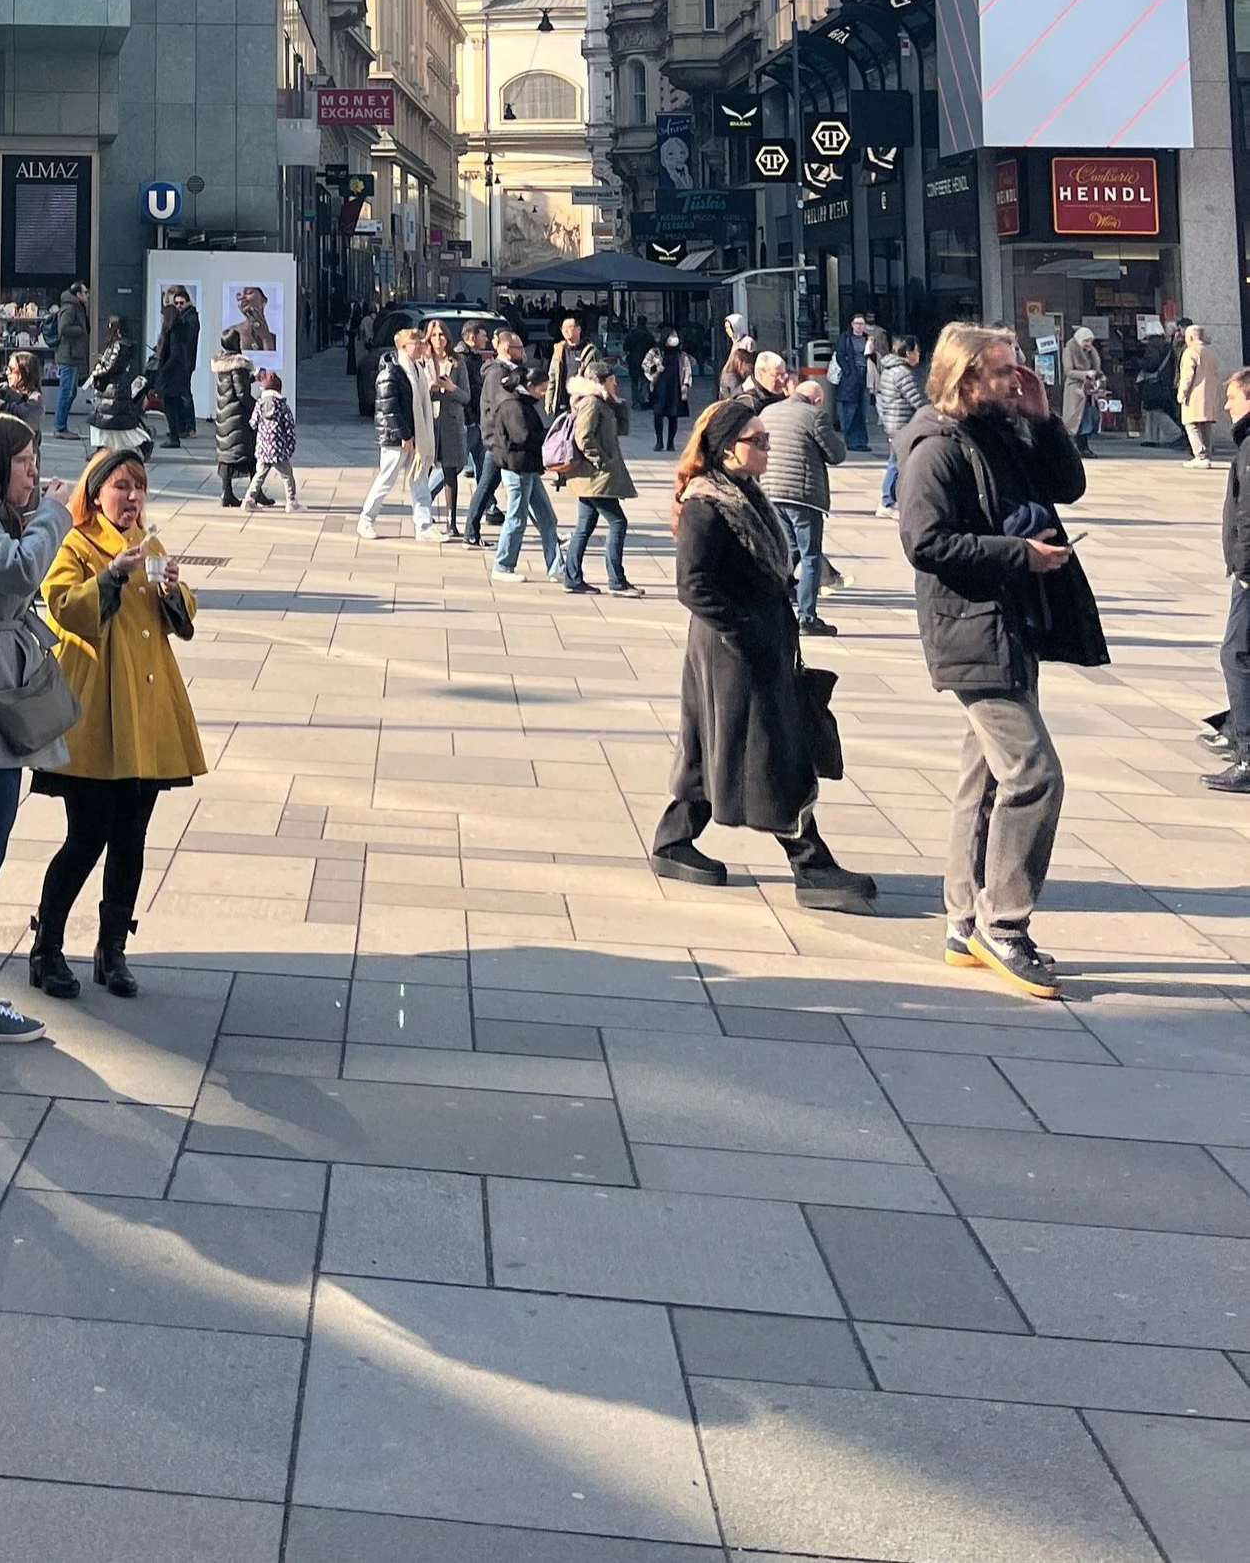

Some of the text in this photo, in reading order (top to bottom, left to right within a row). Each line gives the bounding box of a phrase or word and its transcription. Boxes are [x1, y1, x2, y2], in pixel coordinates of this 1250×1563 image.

[321, 96, 390, 106] MONEY
[321, 108, 391, 118] EXCHANGE
[15, 162, 79, 179] ALMAZ
[1069, 163, 1139, 184] Confiserie
[1059, 186, 1152, 202] HEINDL
[148, 190, 176, 219] U
